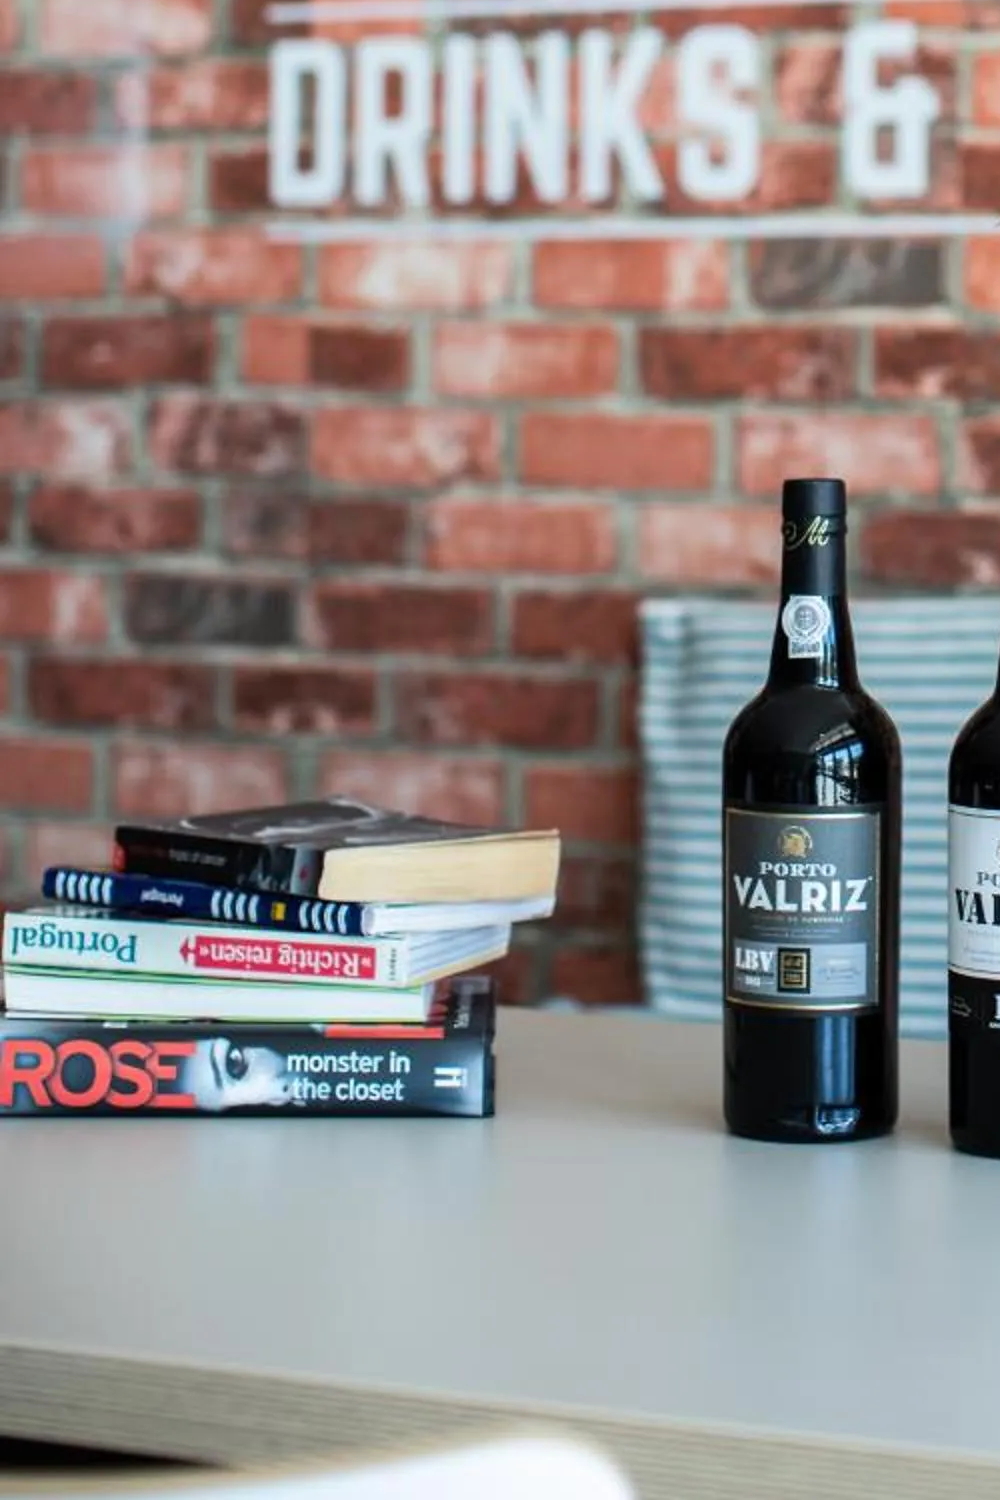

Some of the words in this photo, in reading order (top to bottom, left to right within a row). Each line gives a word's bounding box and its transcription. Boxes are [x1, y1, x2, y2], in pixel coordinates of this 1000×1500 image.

[267, 24, 761, 209] DRINKS
[842, 20, 938, 198] &
[759, 861, 837, 878] PORTO
[733, 874, 868, 913] VALRIZ
[10, 923, 137, 964] Portugal
[734, 947, 775, 973] LBV
[0, 1038, 197, 1109] ROSE
[286, 1051, 384, 1074] monster
[389, 1051, 411, 1074] in
[293, 1077, 331, 1100] the
[335, 1078, 405, 1101] closet
